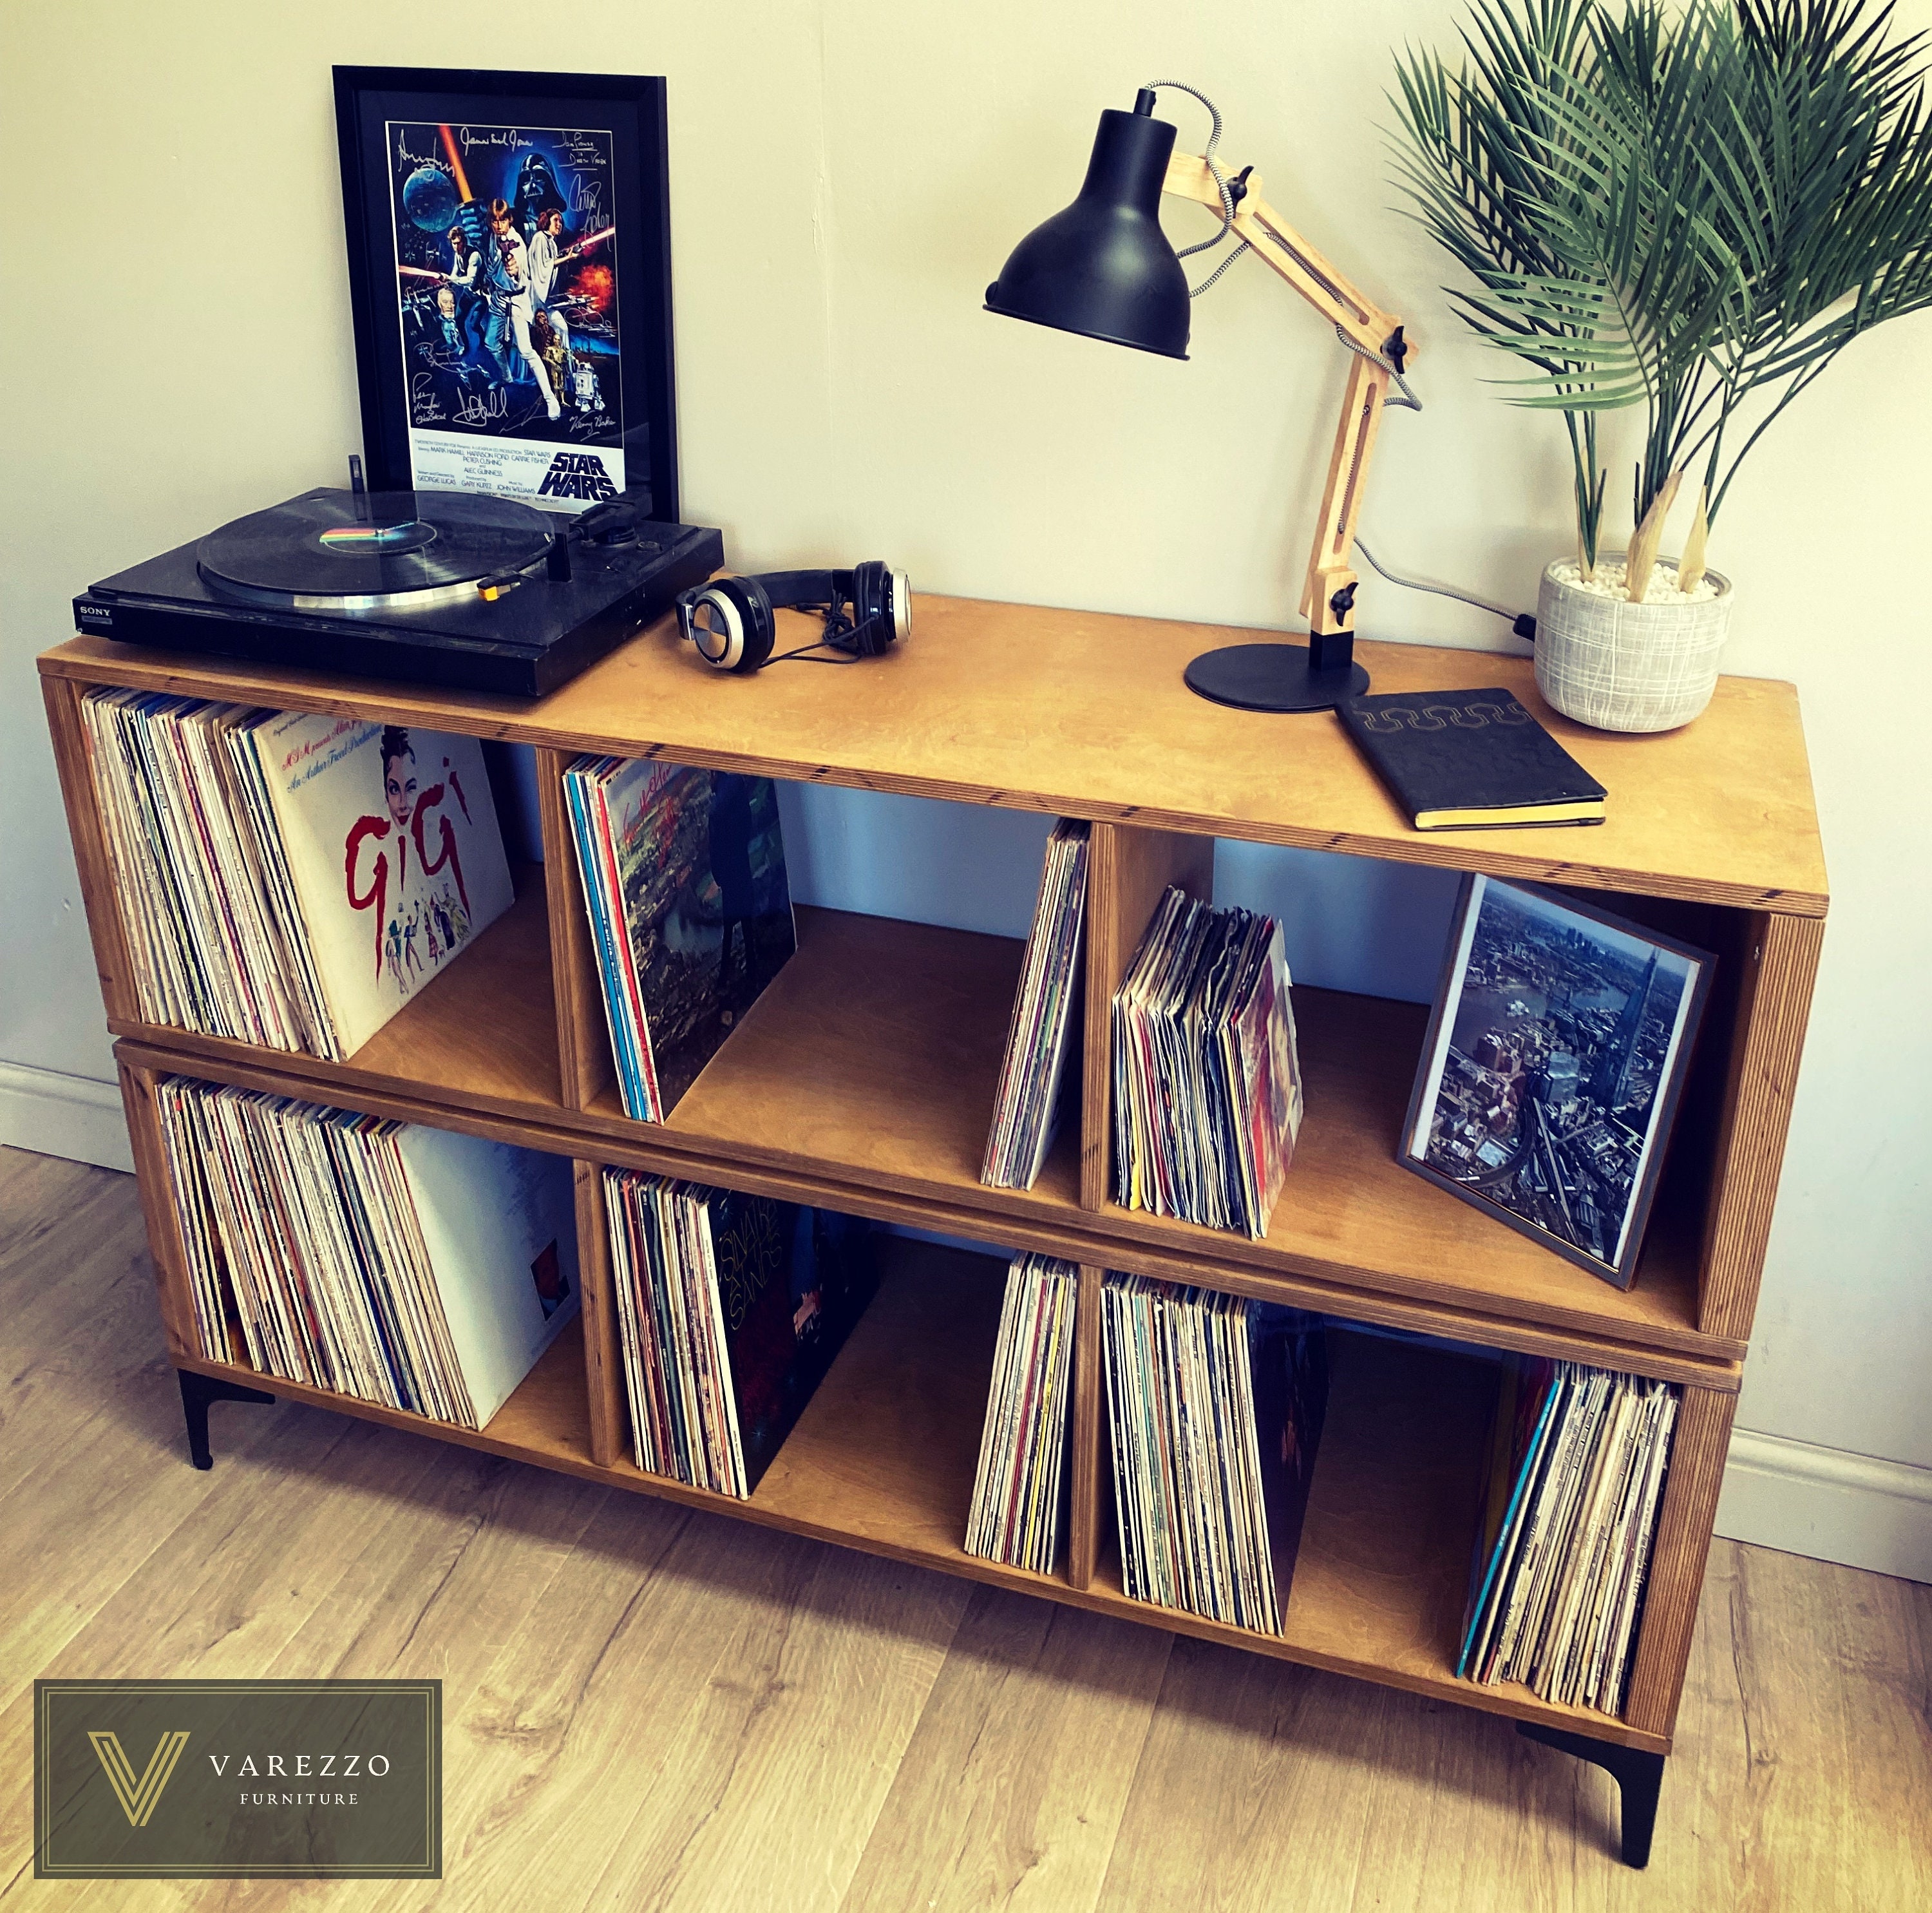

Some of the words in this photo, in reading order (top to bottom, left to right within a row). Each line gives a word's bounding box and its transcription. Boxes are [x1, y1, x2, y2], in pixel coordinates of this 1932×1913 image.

[549, 452, 609, 477] STAR
[537, 471, 619, 502] WARS
[80, 606, 111, 616] SONY
